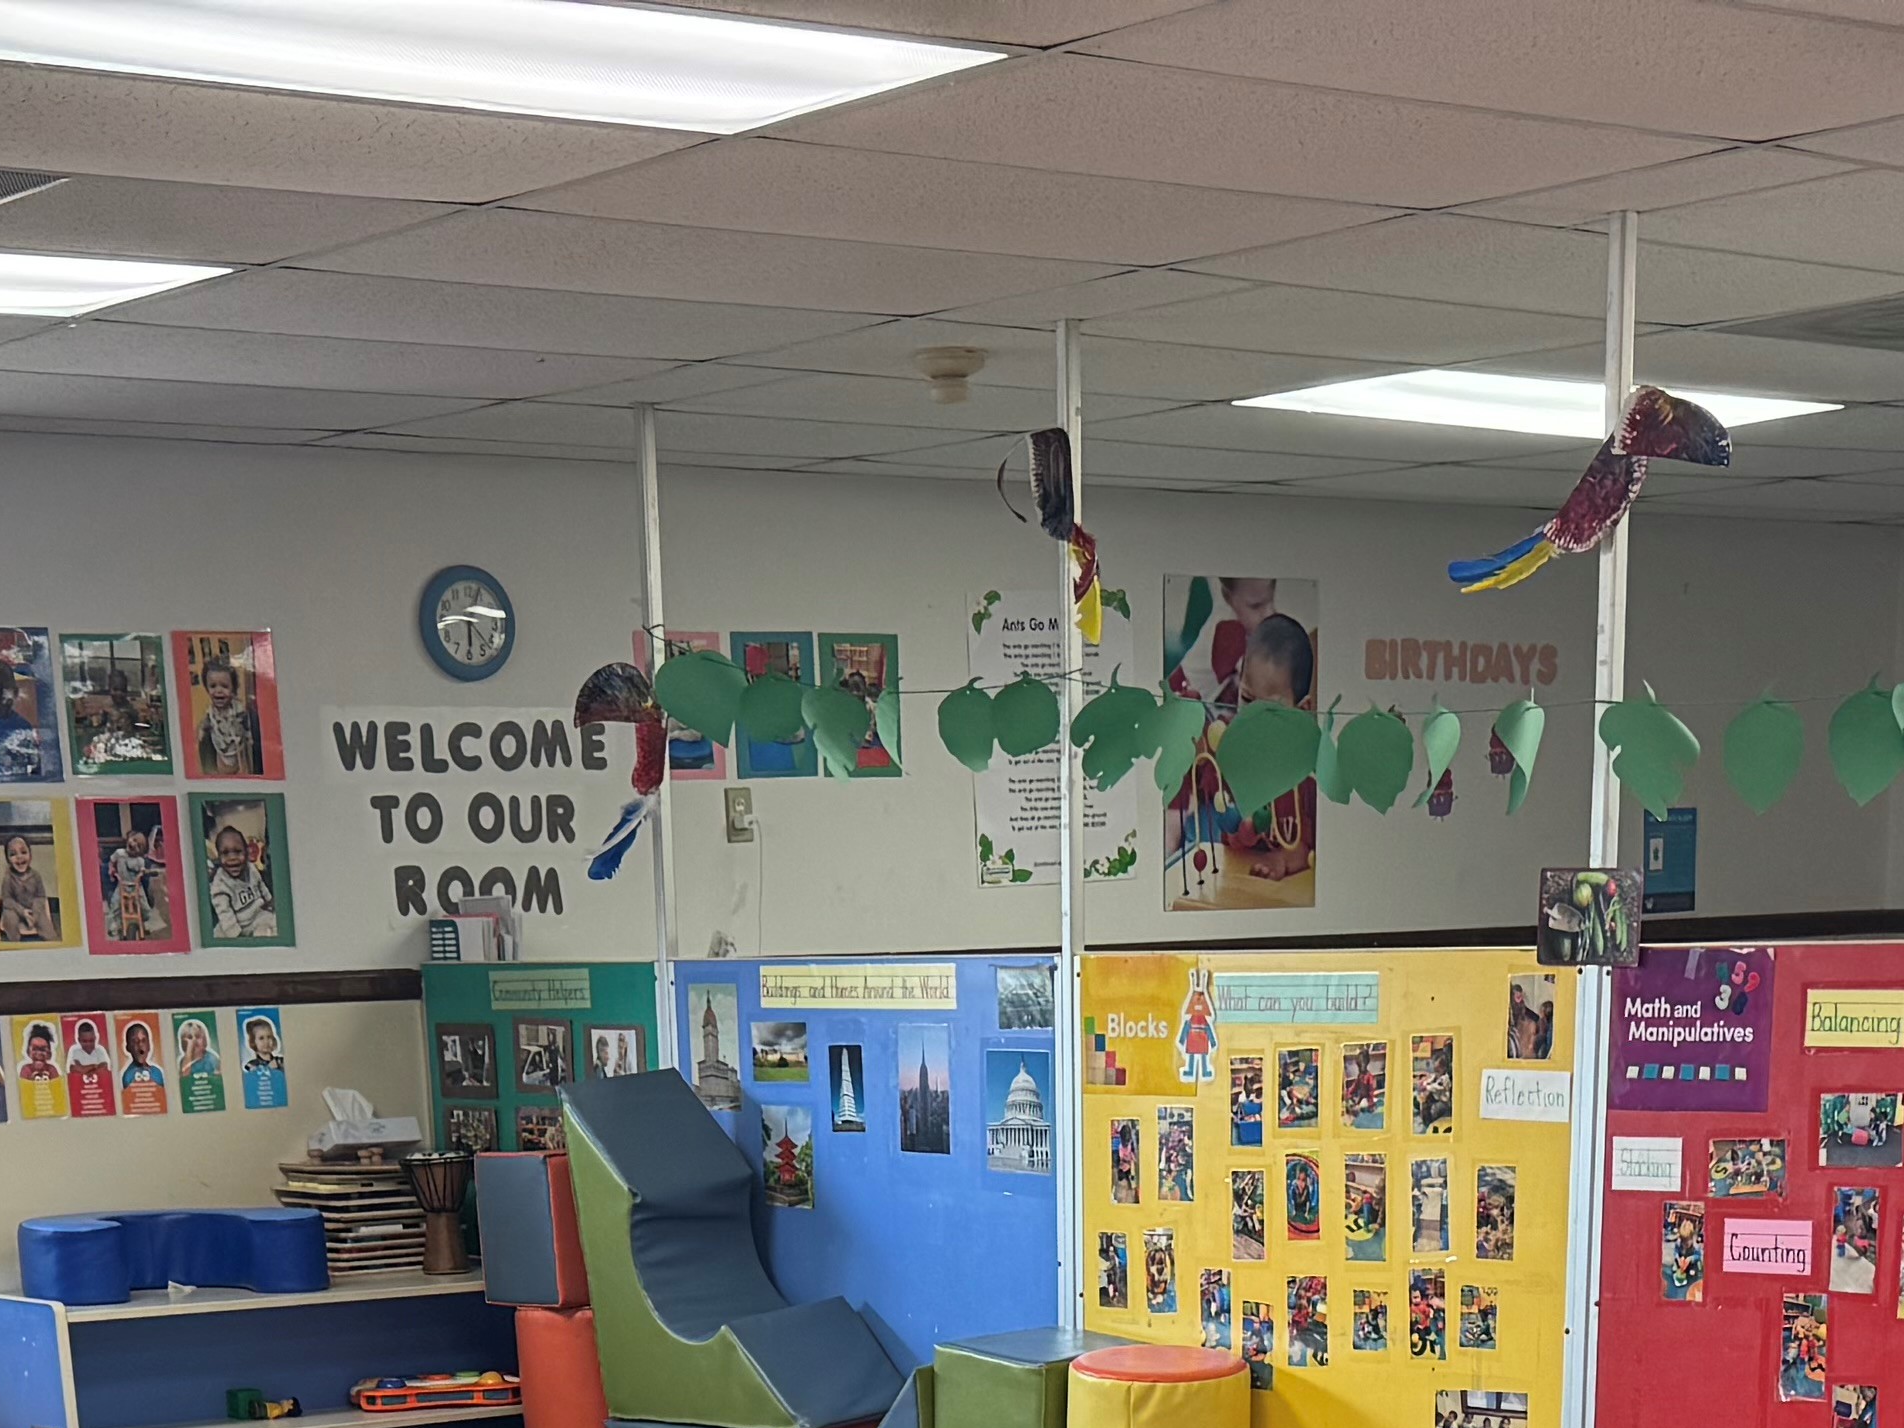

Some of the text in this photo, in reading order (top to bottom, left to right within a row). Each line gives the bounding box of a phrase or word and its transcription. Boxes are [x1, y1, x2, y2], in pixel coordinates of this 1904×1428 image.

[1002, 618, 1026, 632] Ants
[1029, 618, 1045, 631] Go
[1364, 638, 1558, 686] BIRTHDAYS
[332, 719, 608, 774] WELCOME
[370, 792, 576, 844] TO OUR
[394, 865, 564, 917] ROOM
[809, 975, 826, 999] and
[918, 976, 950, 999] World
[1216, 985, 1373, 1023] What can you build?
[1107, 1013, 1169, 1039] Blocks
[1624, 996, 1701, 1019] Math and
[1811, 1001, 1903, 1045] Balancing
[1629, 1020, 1754, 1049] Manipulatives
[1486, 1074, 1565, 1109] Reflection
[1729, 1233, 1807, 1272] Counting
